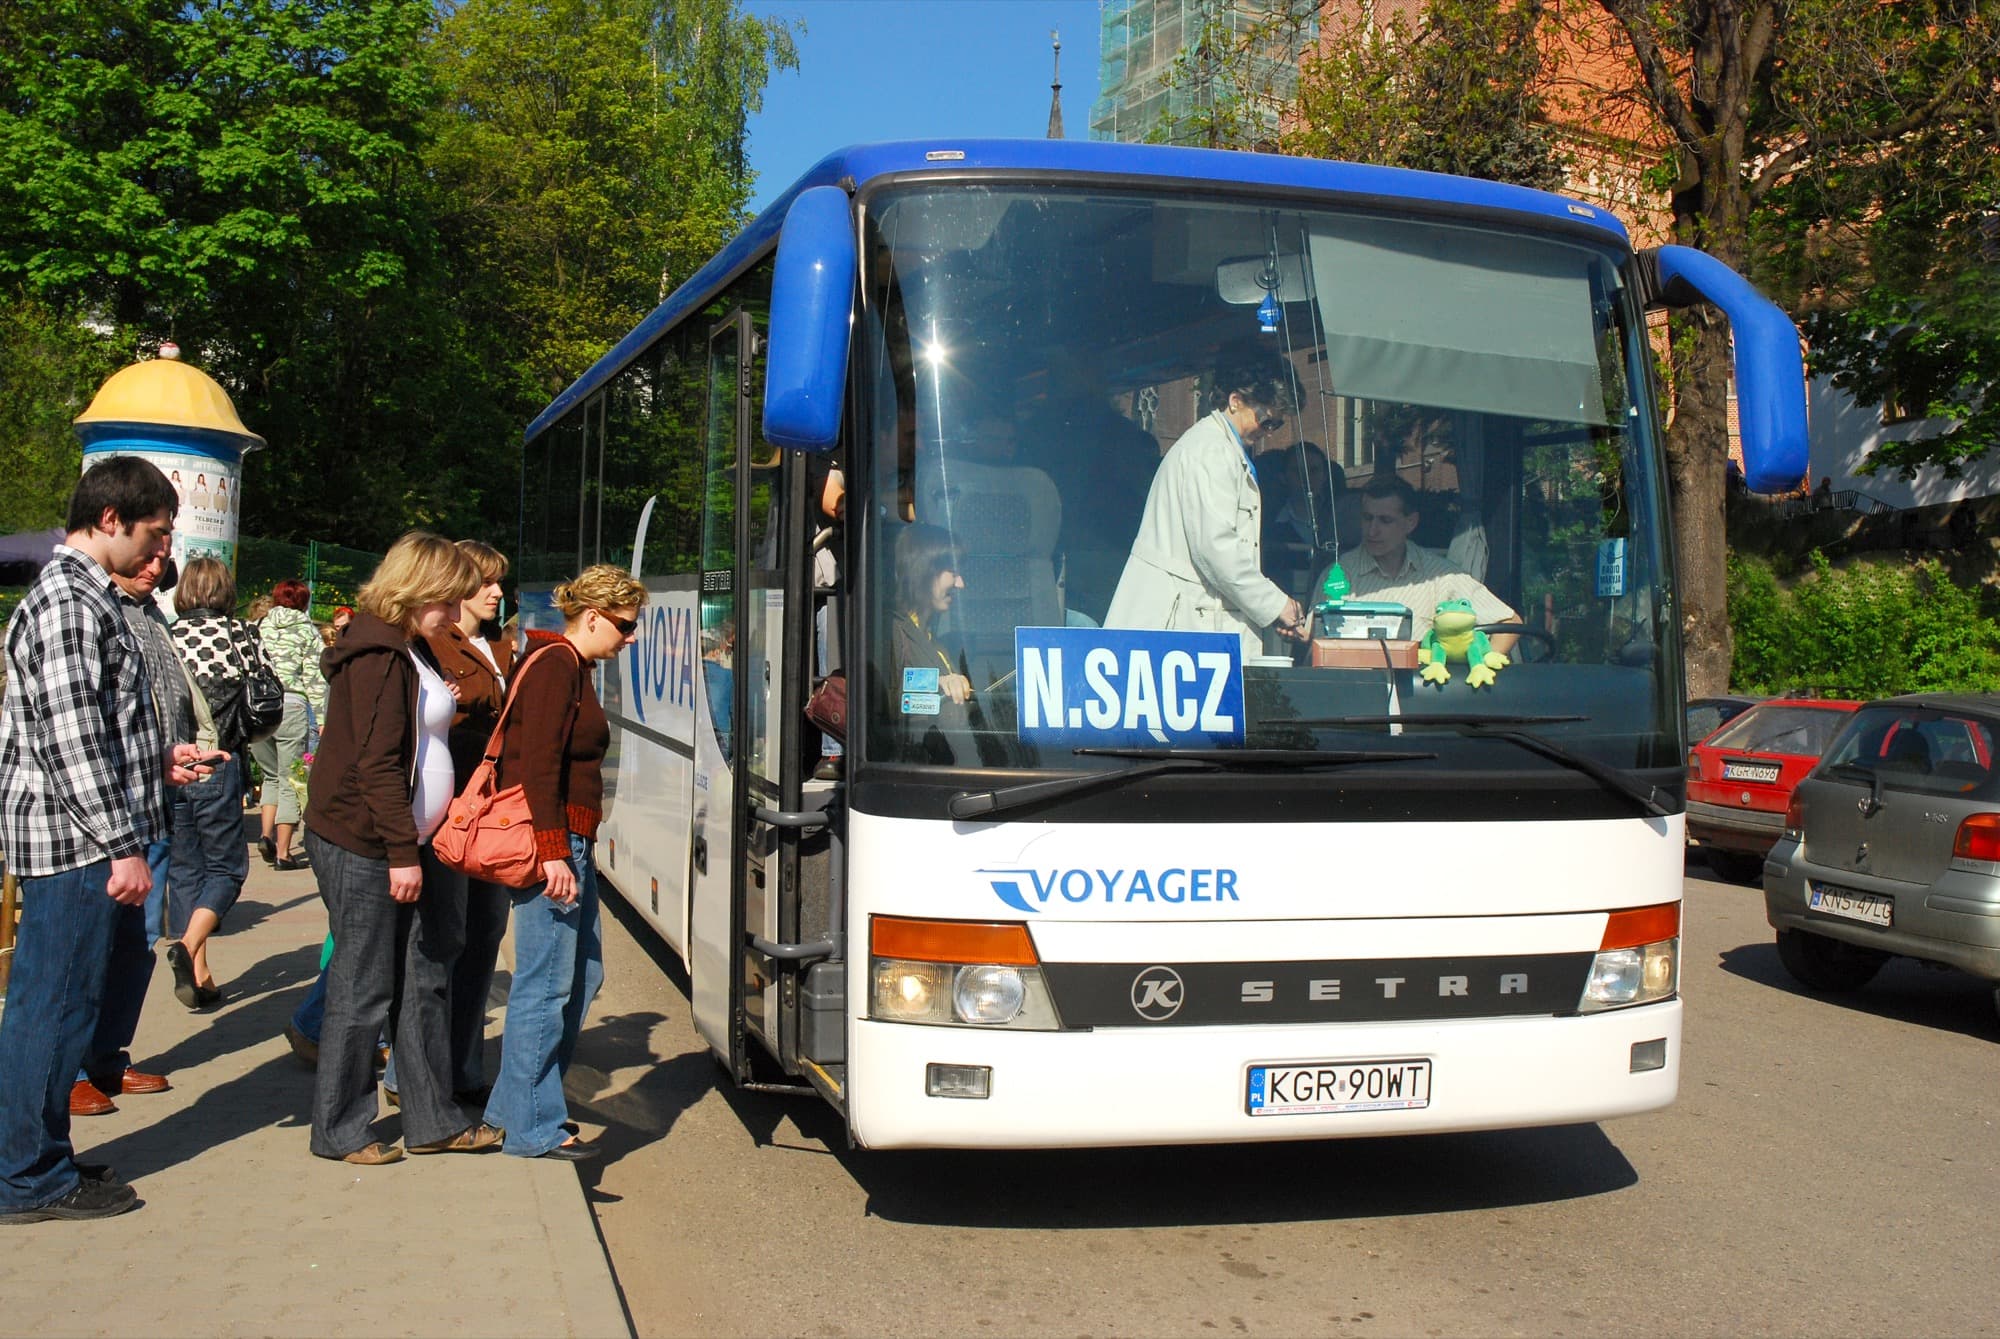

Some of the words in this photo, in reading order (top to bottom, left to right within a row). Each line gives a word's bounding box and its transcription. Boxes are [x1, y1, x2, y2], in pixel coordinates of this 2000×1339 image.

[703, 570, 732, 591] SETRA
[1022, 647, 1235, 744] N.SĄCZ
[1028, 868, 1240, 904] VOYAGER
[1821, 886, 1853, 911] KNS
[1241, 973, 1529, 1002] SETRA
[1250, 1092, 1263, 1103] PL
[1269, 1069, 1337, 1104] KGR
[1349, 1065, 1424, 1101] 90WT
